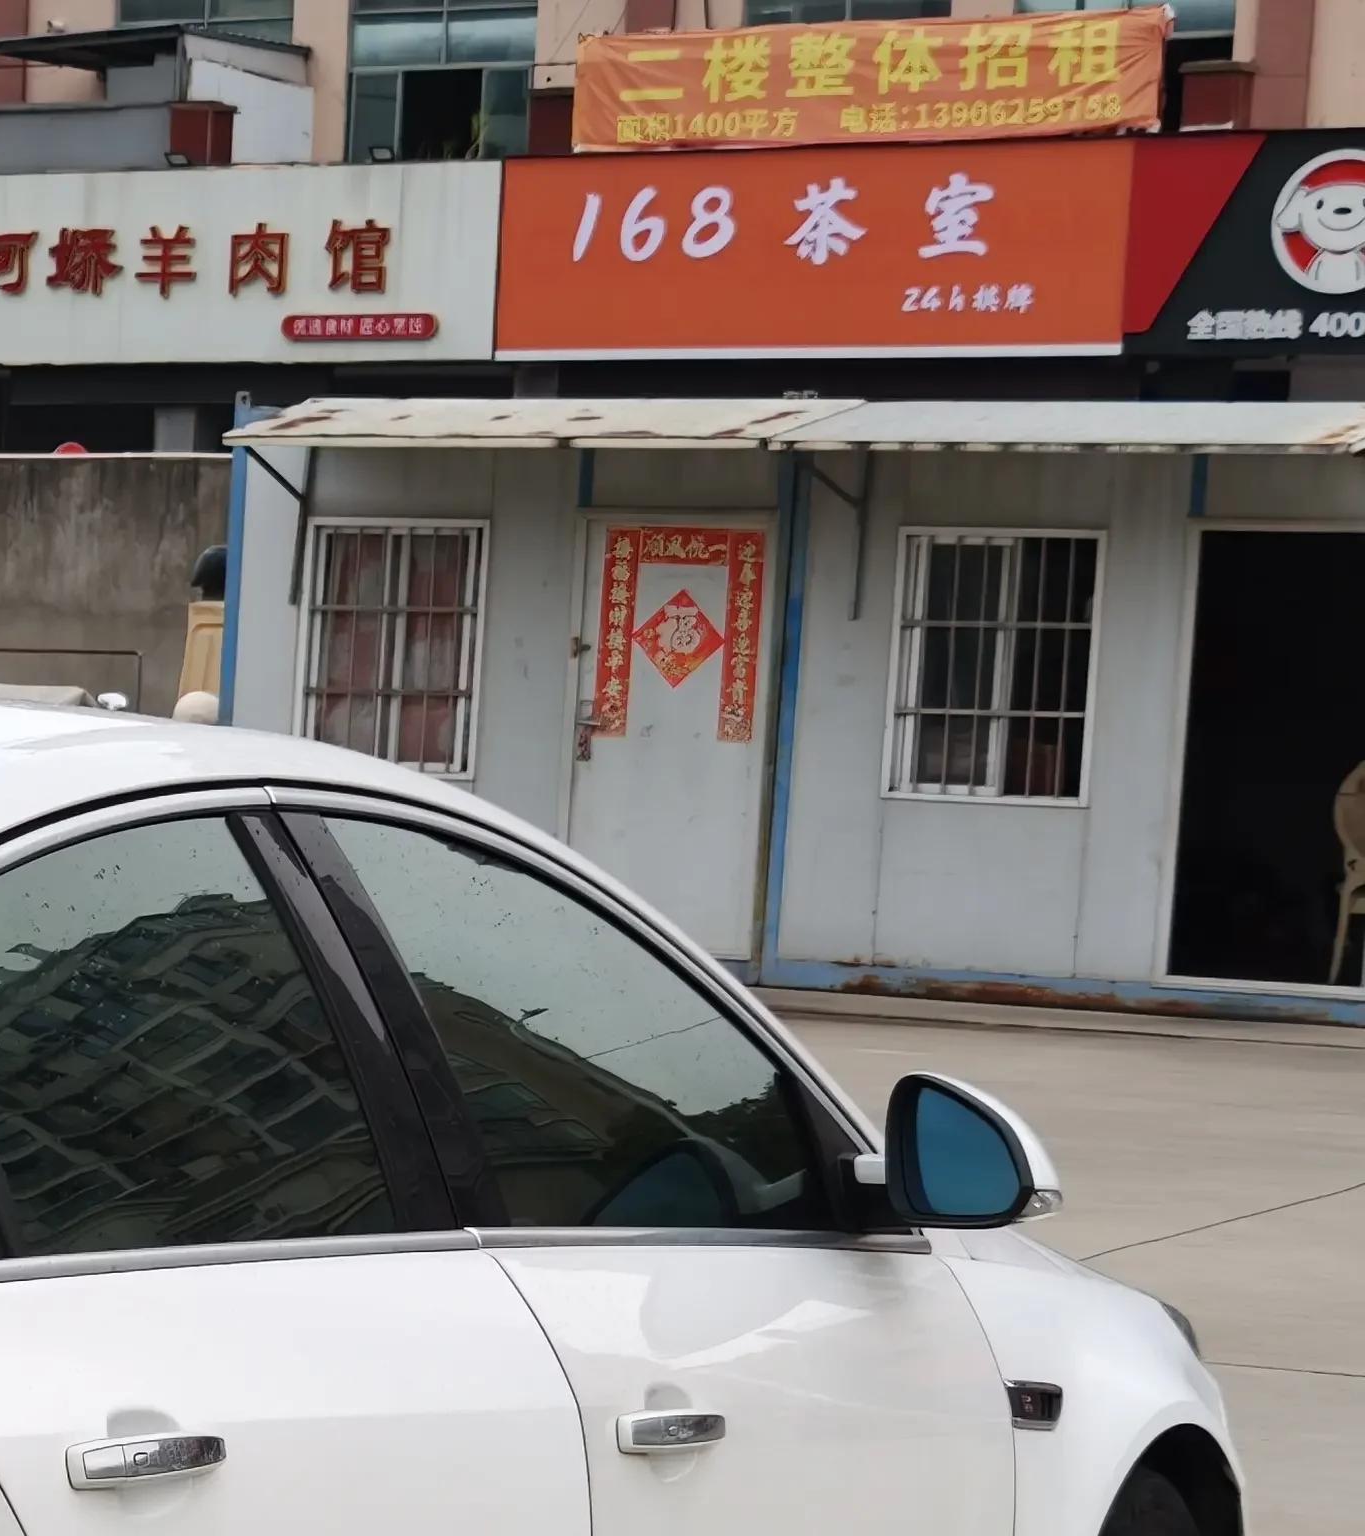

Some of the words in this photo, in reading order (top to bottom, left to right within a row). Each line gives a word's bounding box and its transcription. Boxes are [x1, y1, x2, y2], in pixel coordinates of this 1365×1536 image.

[620, 20, 1121, 102] 二楼整体招租
